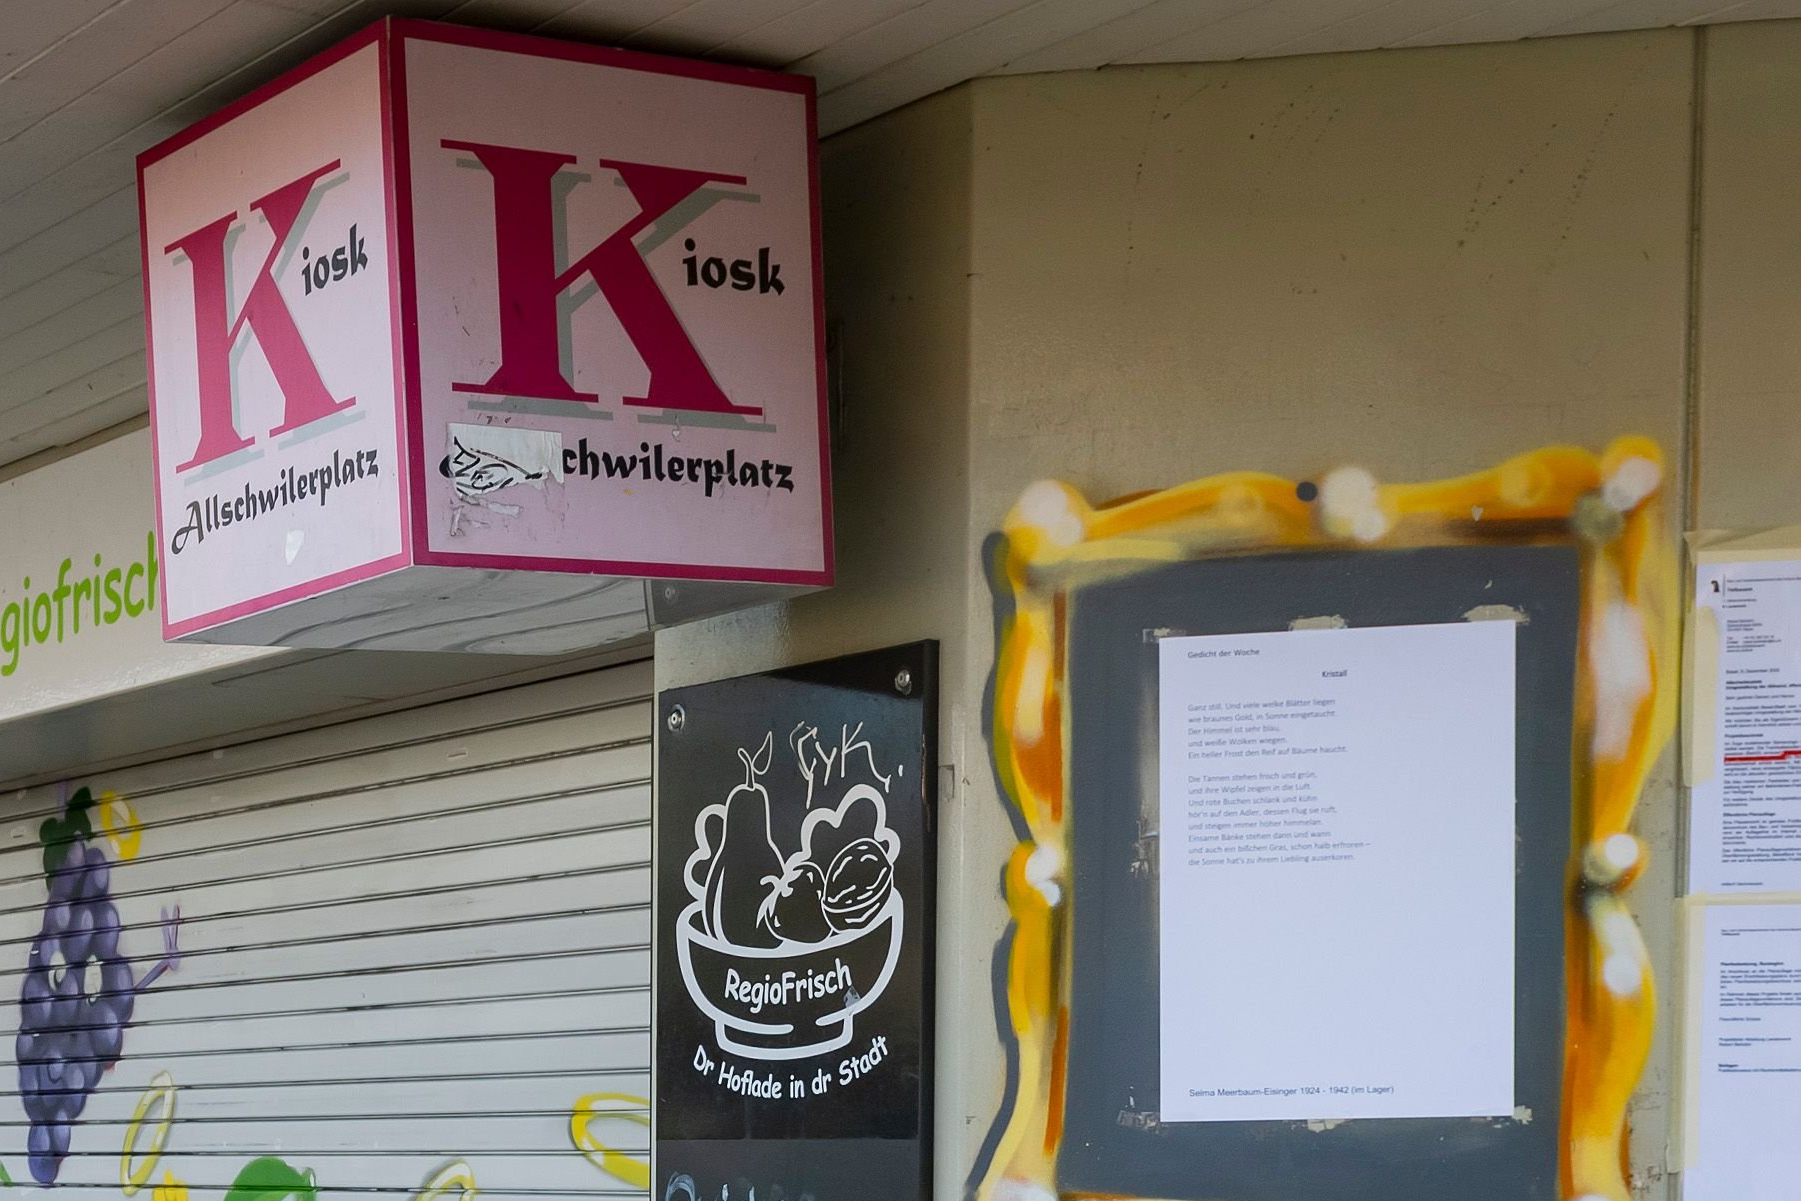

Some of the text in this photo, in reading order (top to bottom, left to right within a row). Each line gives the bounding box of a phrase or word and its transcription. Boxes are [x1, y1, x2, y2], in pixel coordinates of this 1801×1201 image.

[439, 438, 795, 497] chwilerplatz
[171, 445, 379, 556] Allschwilerplatz
[1187, 648, 1260, 658] Gedicht der Woche
[1321, 669, 1347, 677] Kristall
[724, 958, 853, 1015] RegioFrisch
[693, 1034, 889, 1100] Dr Hoflade in dr Stadt
[1216, 1088, 1297, 1097] Meerbaum-Eisinger
[1350, 1087, 1364, 1095] (im
[1366, 1087, 1394, 1095] Lager)
